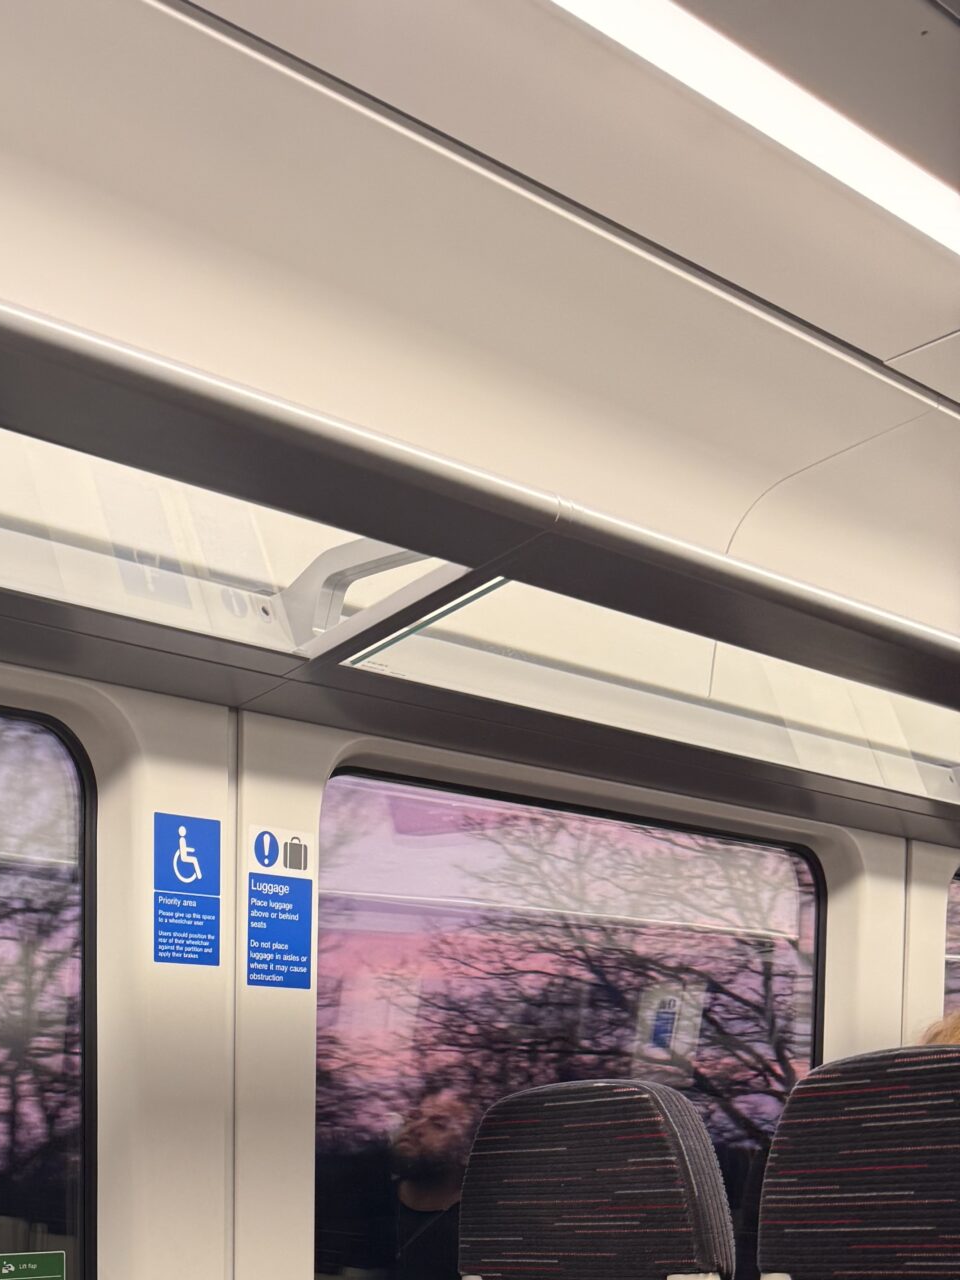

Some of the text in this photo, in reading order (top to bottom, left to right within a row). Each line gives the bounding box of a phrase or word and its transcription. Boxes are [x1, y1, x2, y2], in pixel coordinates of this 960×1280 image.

[251, 879, 289, 895] Luggage
[158, 896, 181, 907] Priority
[251, 898, 293, 910] Place luggage
[251, 910, 269, 918] above
[279, 912, 299, 920] behind
[250, 939, 259, 947] Do
[272, 942, 288, 950] place
[250, 951, 274, 960] luggage
[250, 962, 267, 970] where
[276, 965, 288, 973] may
[250, 973, 283, 981] obstruction
